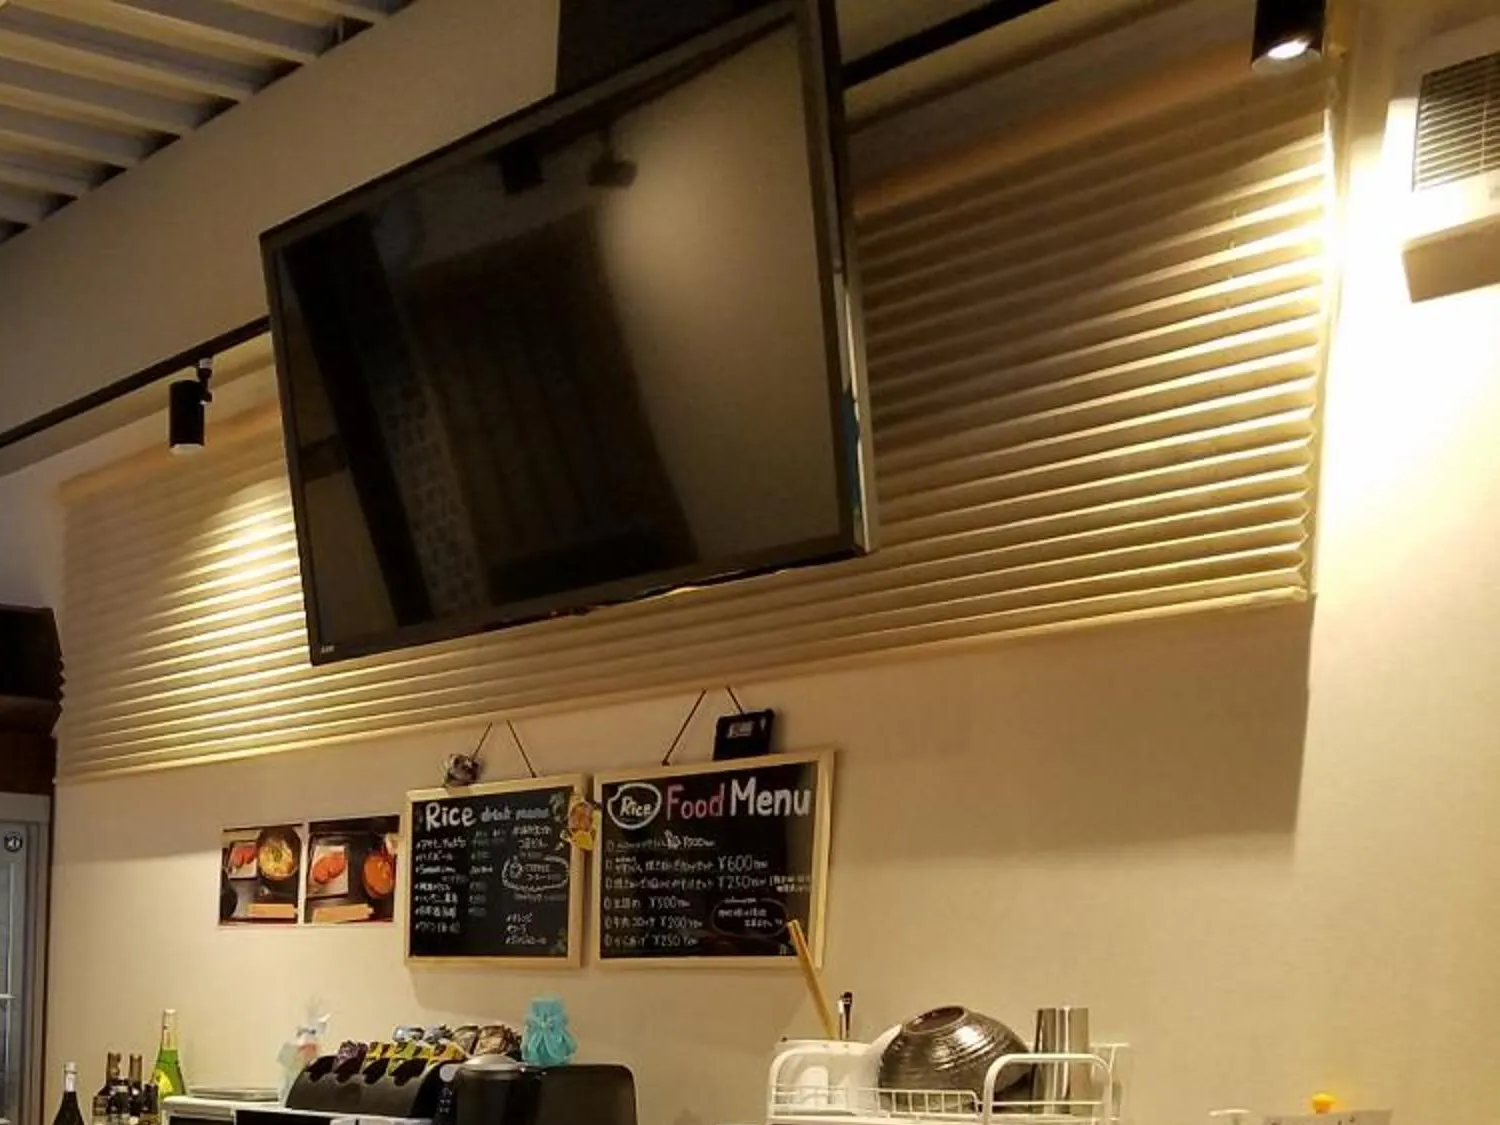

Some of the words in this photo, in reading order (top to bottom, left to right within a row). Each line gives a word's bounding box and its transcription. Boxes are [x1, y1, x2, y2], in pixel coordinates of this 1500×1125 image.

[619, 796, 652, 817] Rice
[666, 783, 725, 820] Food
[729, 777, 812, 817] Menu
[425, 802, 477, 832] Rice
